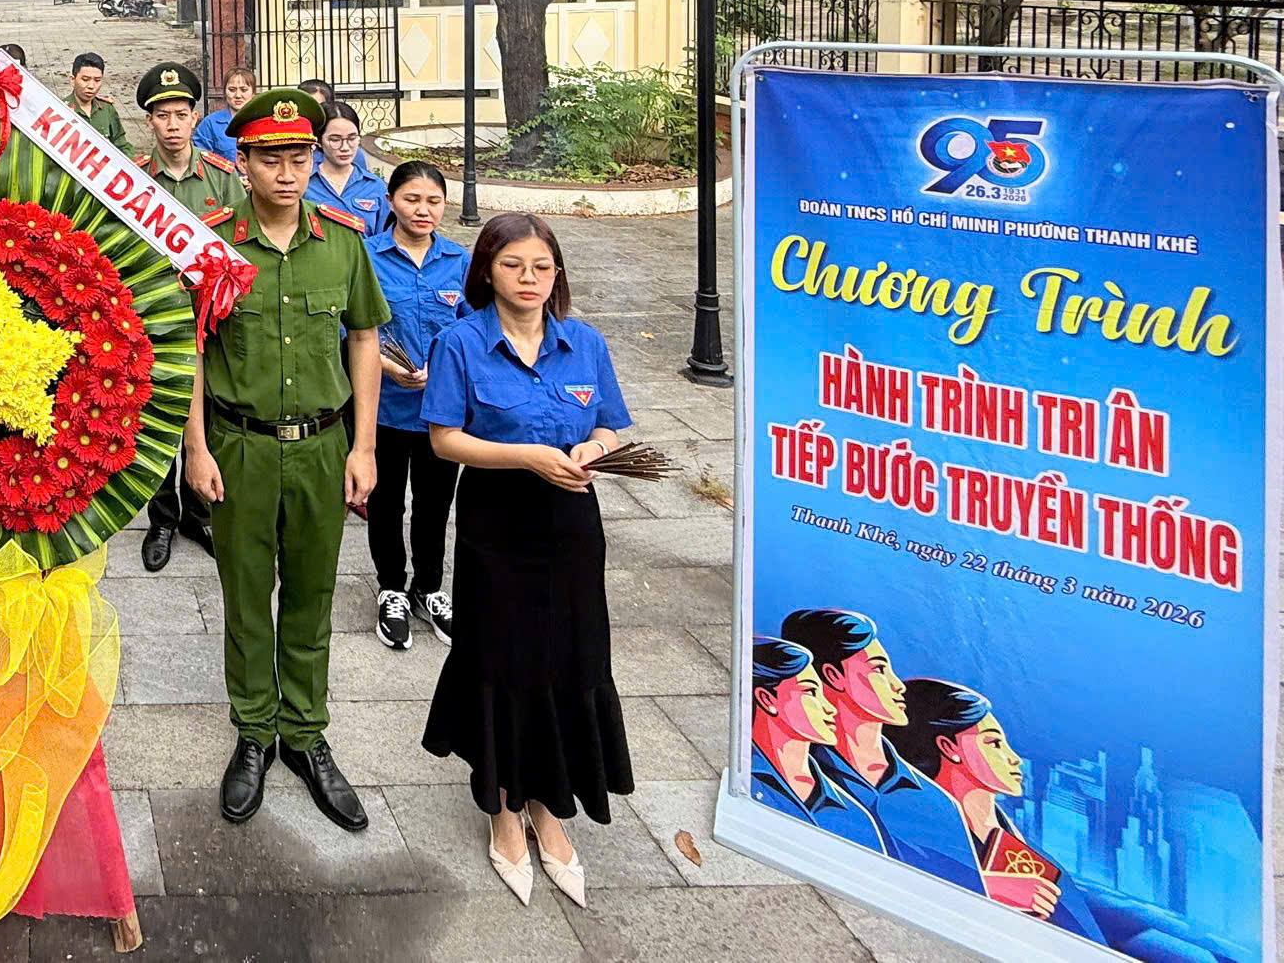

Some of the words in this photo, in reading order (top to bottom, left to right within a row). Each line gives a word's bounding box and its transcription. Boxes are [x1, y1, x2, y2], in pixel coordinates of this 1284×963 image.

[31, 106, 111, 181] KÍNH
[103, 168, 194, 254] DÂNG
[919, 117, 1047, 195] 95
[965, 184, 1001, 200] 26.3
[1002, 194, 1027, 202] 2026
[1003, 188, 1027, 196] 1931
[799, 199, 842, 217] ĐOÀN
[845, 204, 887, 222] TNCS
[918, 211, 948, 228] CHÍ
[952, 216, 1000, 234] MINH
[1004, 220, 1080, 242] PHƯỜNG
[1084, 227, 1151, 249] THANH
[1156, 235, 1199, 255] KHÊ
[770, 234, 1002, 345] Chương
[1019, 266, 1241, 356] Trình
[821, 344, 910, 424] HÀNH
[920, 365, 1024, 447] TRÌNH
[1036, 395, 1096, 460] TRI
[1107, 390, 1166, 475] ÂN
[771, 421, 835, 486] TIẾP
[846, 439, 936, 513] BƯỚC
[945, 473, 1086, 551] TRUYỀN
[1097, 496, 1241, 588] THỐNG
[792, 505, 852, 534] Thanh
[856, 523, 901, 551] Khê,
[906, 540, 957, 567] ngày
[960, 552, 988, 572] 22
[992, 560, 1058, 594] tháng
[1062, 577, 1077, 595] 3
[1082, 585, 1137, 611] năm
[1141, 597, 1205, 629] 2026
